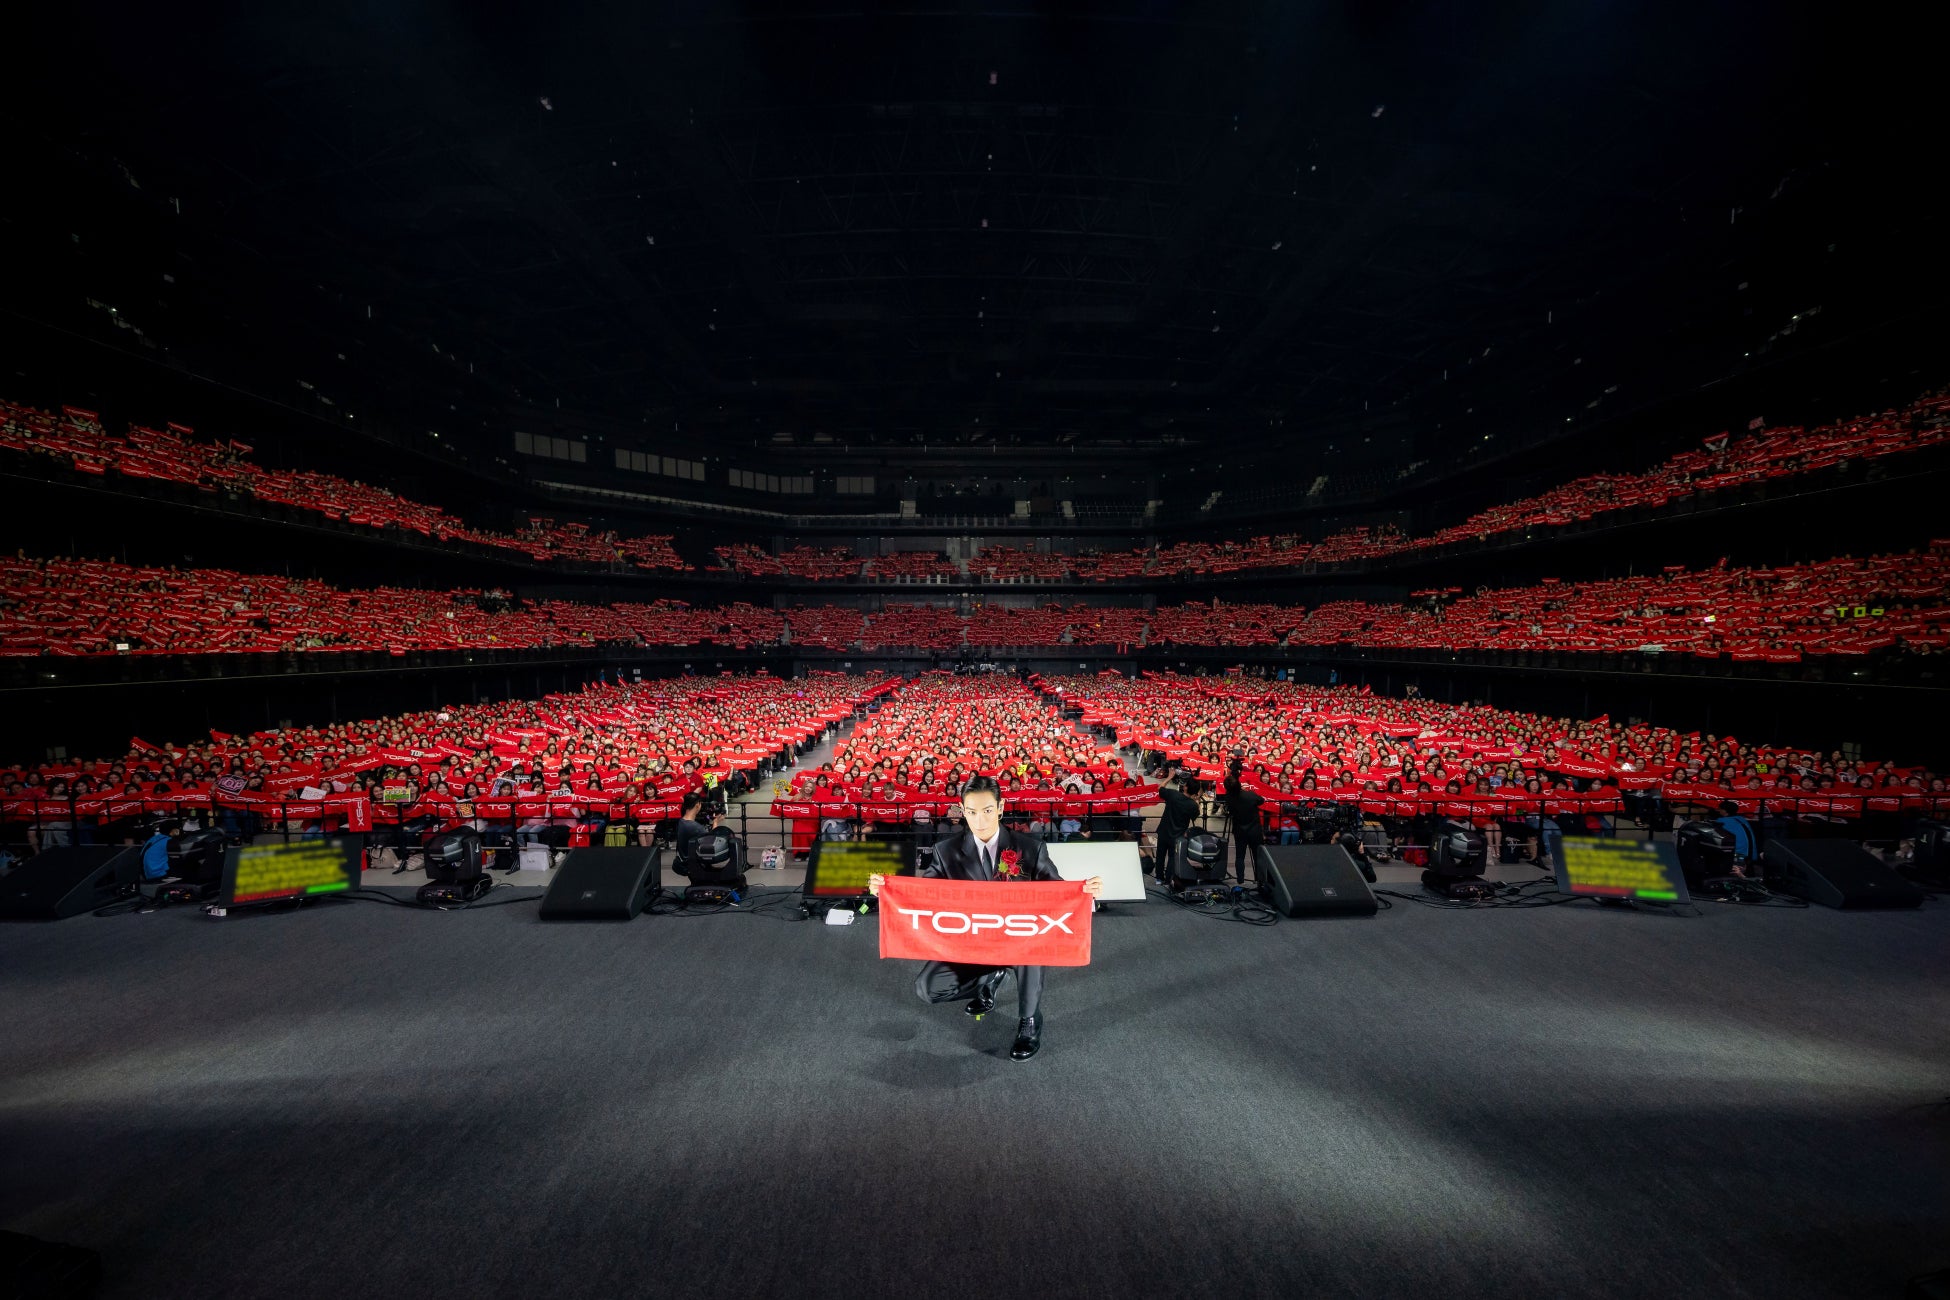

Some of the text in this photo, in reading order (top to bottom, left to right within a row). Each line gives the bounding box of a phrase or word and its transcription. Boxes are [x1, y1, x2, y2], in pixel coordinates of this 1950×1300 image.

[382, 754, 419, 762] TOPSX
[1564, 763, 1606, 775] TOPSX
[267, 774, 315, 785] TOPSX
[656, 784, 686, 795] OPSX
[1119, 791, 1160, 802] TOPSX
[638, 805, 680, 815] TOPSX
[1448, 801, 1486, 813] OPSX
[898, 908, 1074, 937] TOPSX
